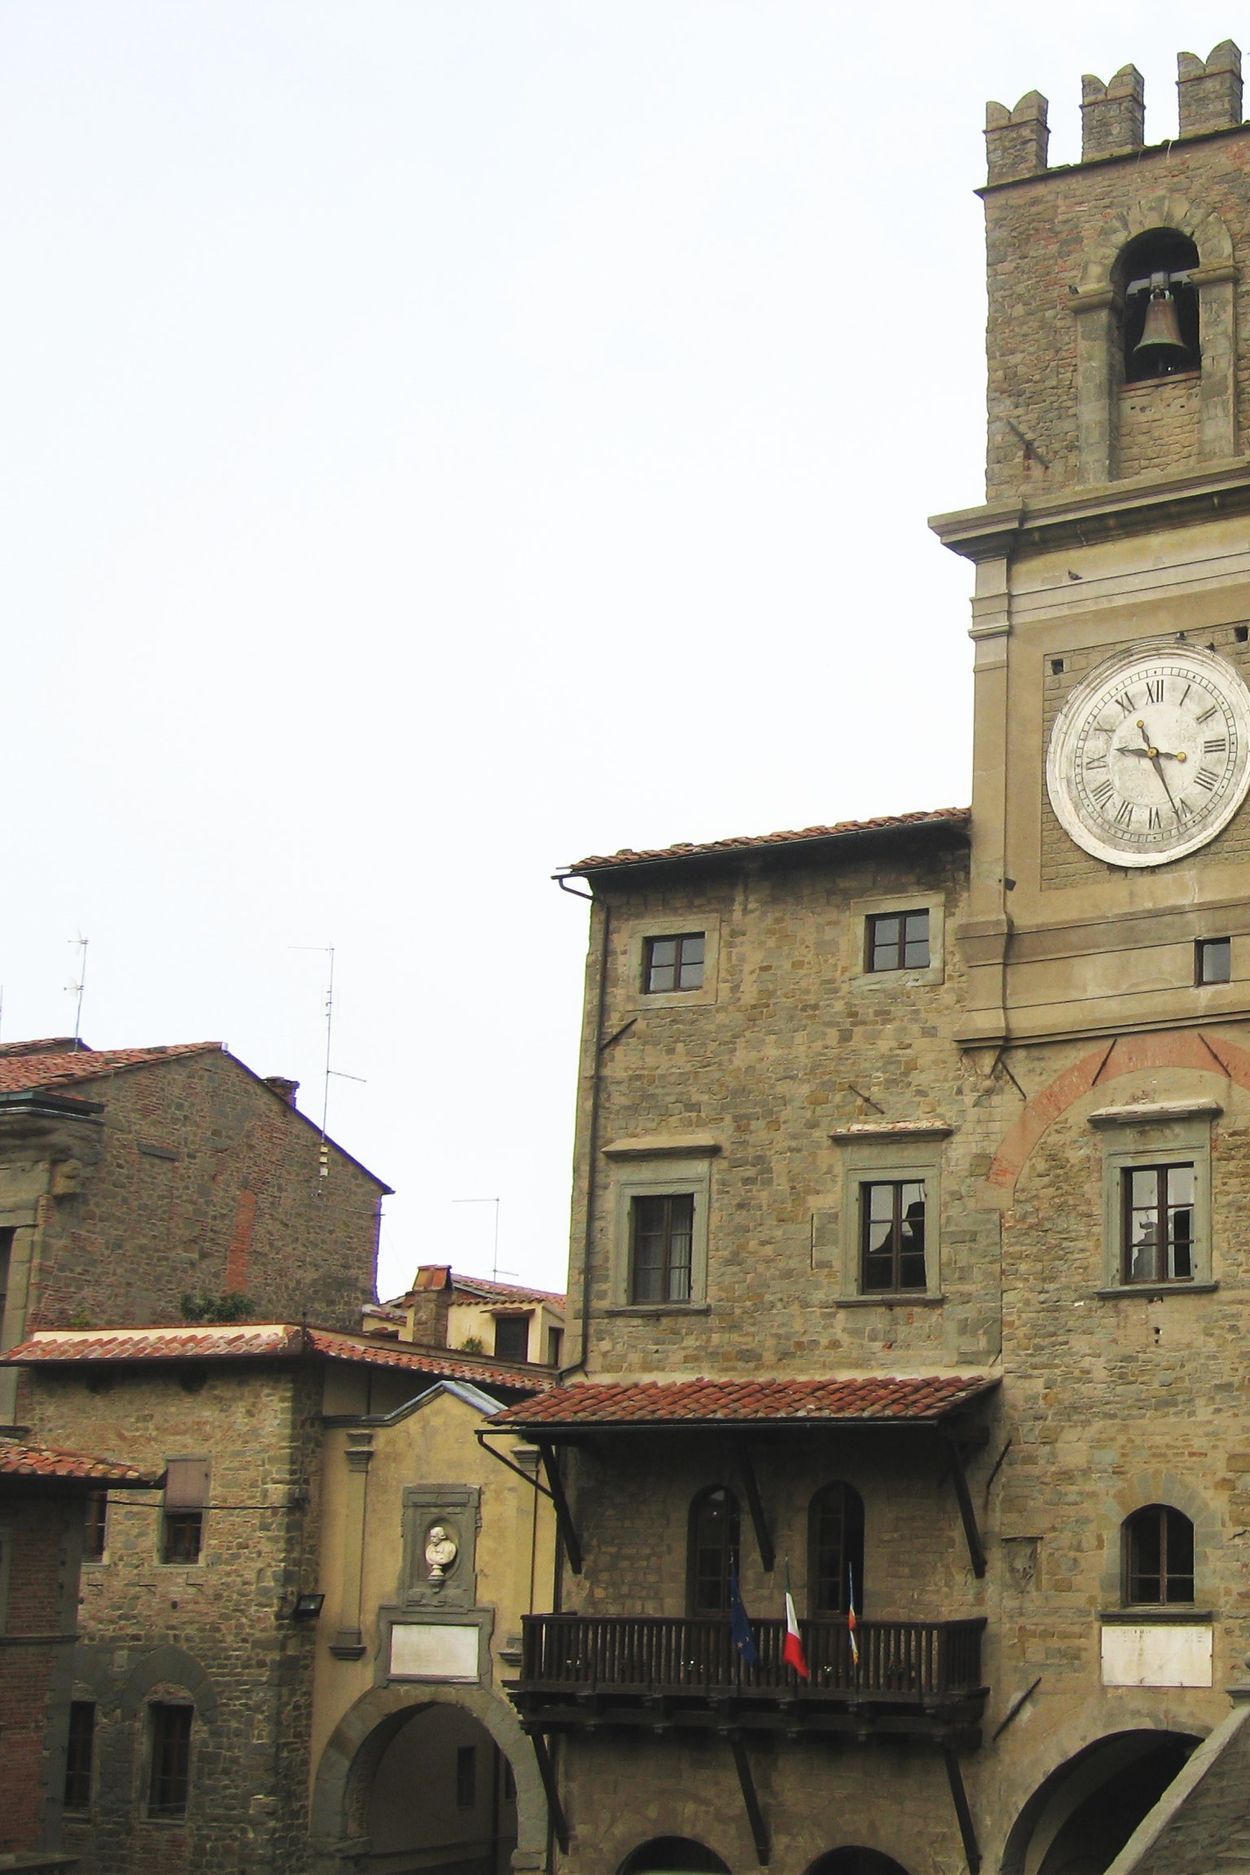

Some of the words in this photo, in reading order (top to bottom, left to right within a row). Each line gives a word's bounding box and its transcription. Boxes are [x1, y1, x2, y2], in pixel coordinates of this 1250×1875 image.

[1146, 680, 1164, 705] XII
[1115, 692, 1135, 719] XI
[1196, 705, 1218, 724] II
[1094, 721, 1116, 739] X
[1204, 738, 1226, 754] III
